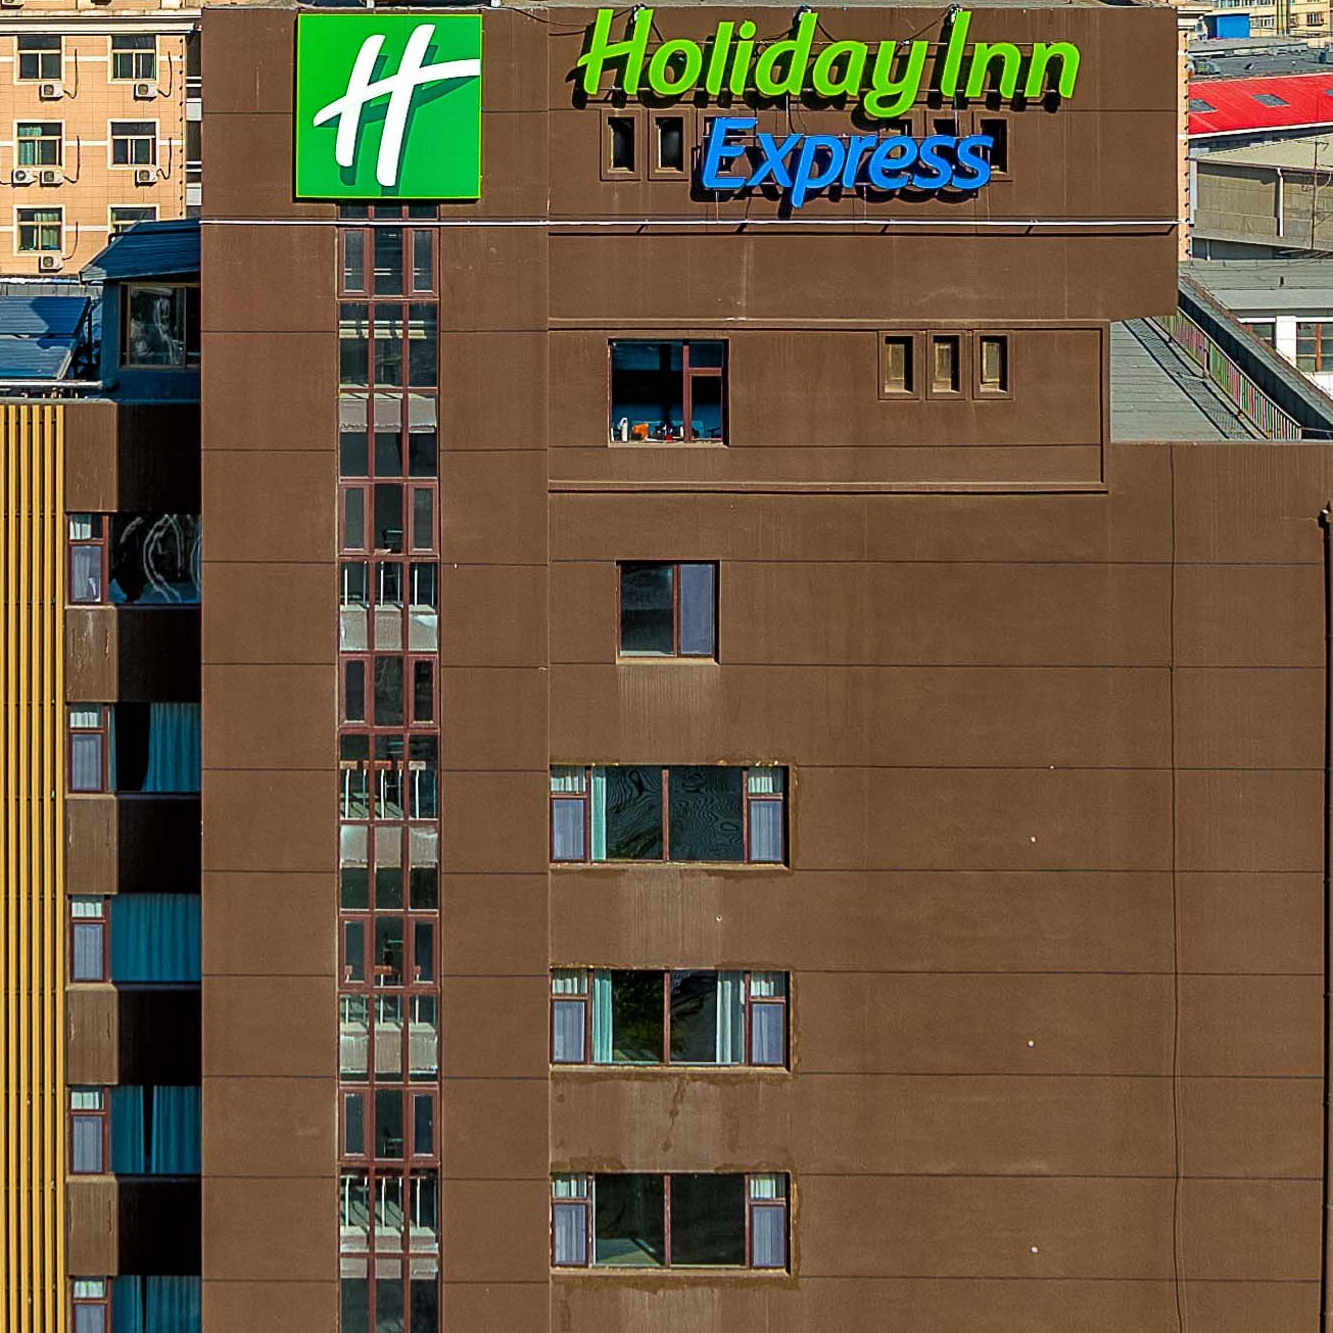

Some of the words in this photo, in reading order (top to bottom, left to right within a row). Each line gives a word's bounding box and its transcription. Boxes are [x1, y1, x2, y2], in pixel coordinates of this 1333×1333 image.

[576, 8, 929, 119] Holiday
[940, 9, 1082, 99] Inn
[702, 116, 995, 209] Express
